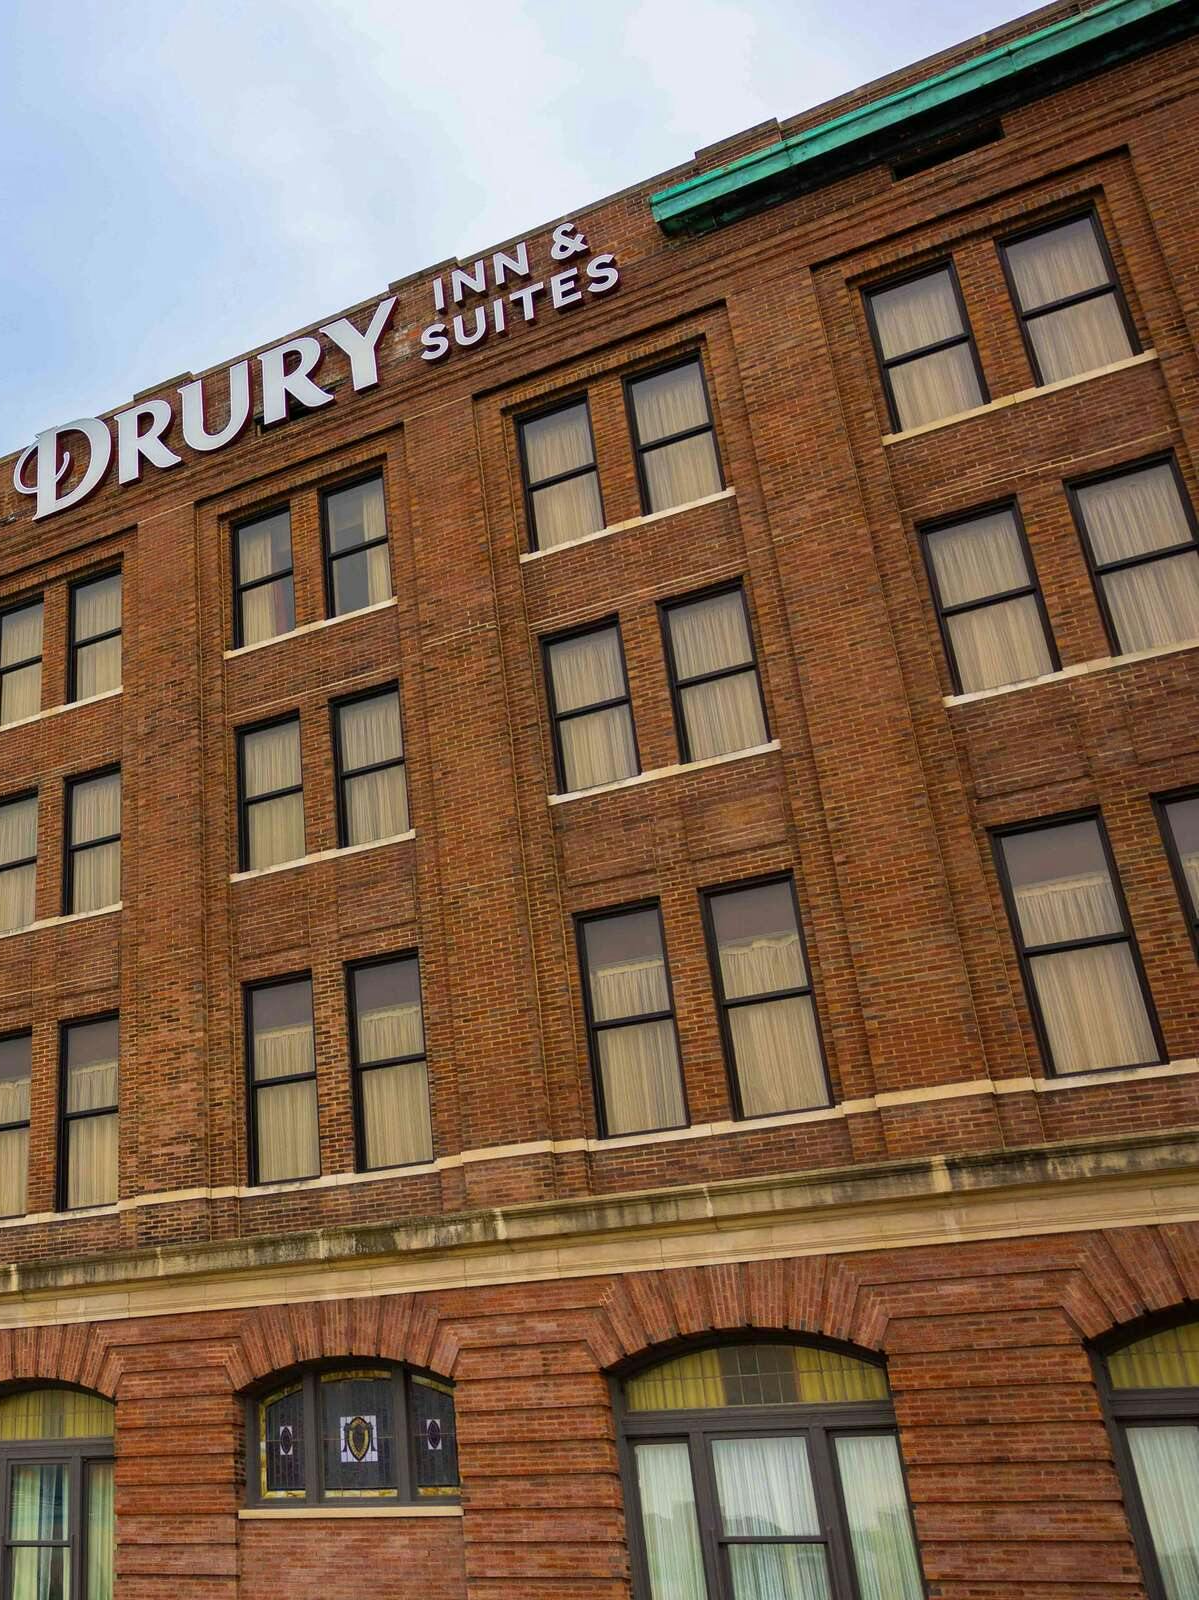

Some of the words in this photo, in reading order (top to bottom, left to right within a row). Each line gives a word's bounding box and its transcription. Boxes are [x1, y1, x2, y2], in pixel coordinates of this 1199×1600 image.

[420, 254, 619, 361] SUITES
[432, 241, 530, 310] INN
[550, 222, 588, 260] &
[13, 297, 397, 520] DRURY
